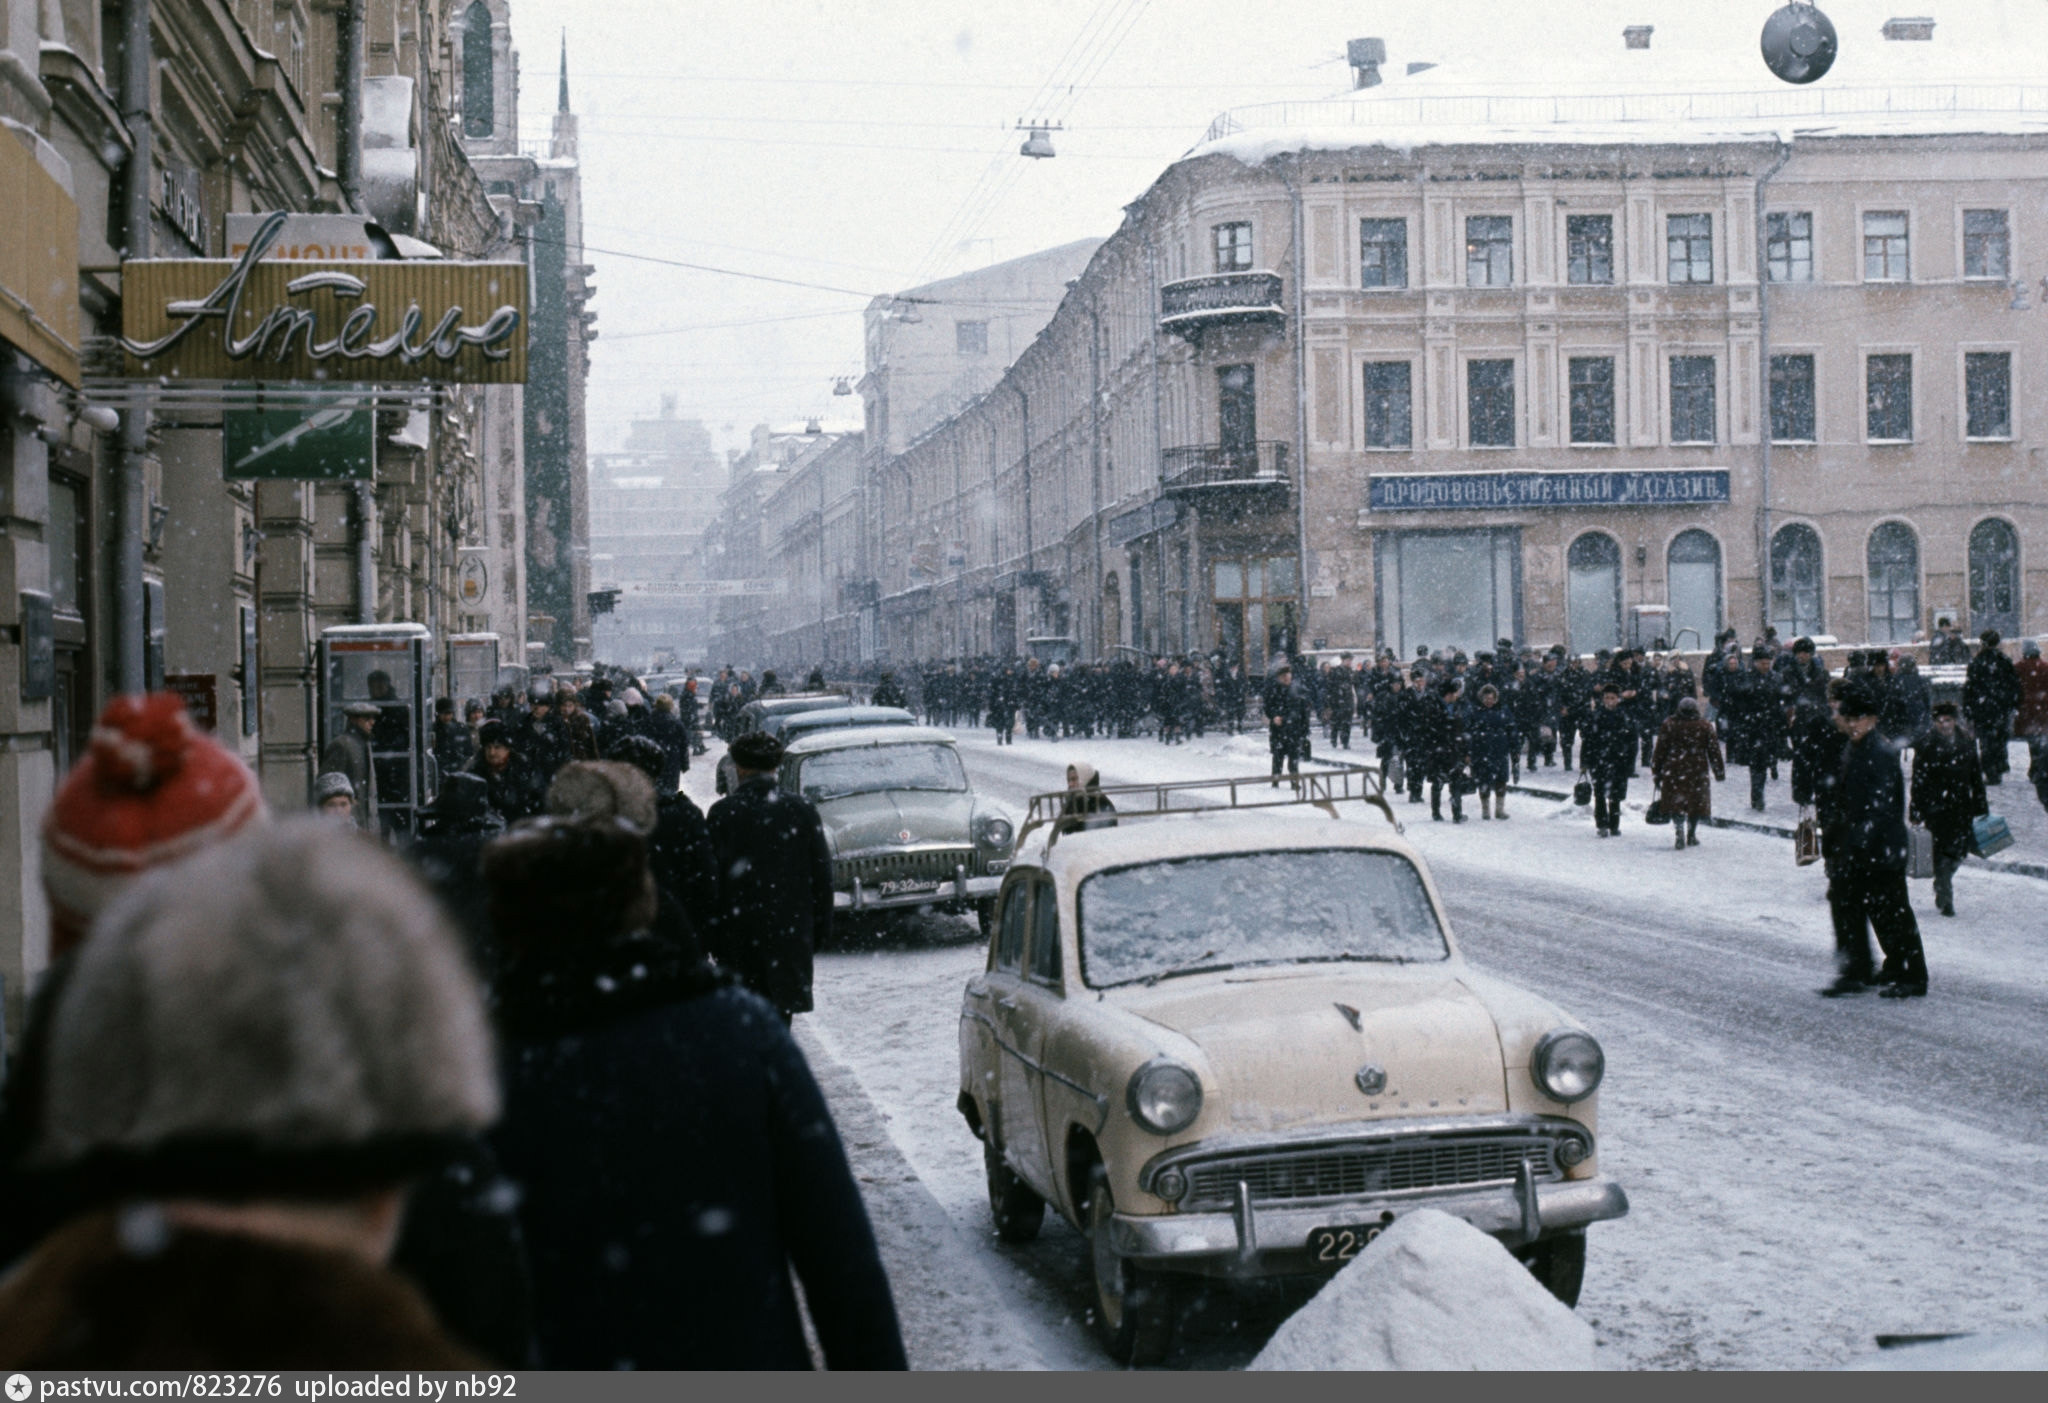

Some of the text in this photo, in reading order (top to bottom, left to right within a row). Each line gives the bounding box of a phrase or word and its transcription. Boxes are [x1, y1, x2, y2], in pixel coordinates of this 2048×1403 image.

[122, 211, 520, 362] Ателье
[1383, 475, 1719, 504] ПРОДОВОЛЬСТВЕННЫЙ МАГАЗИН
